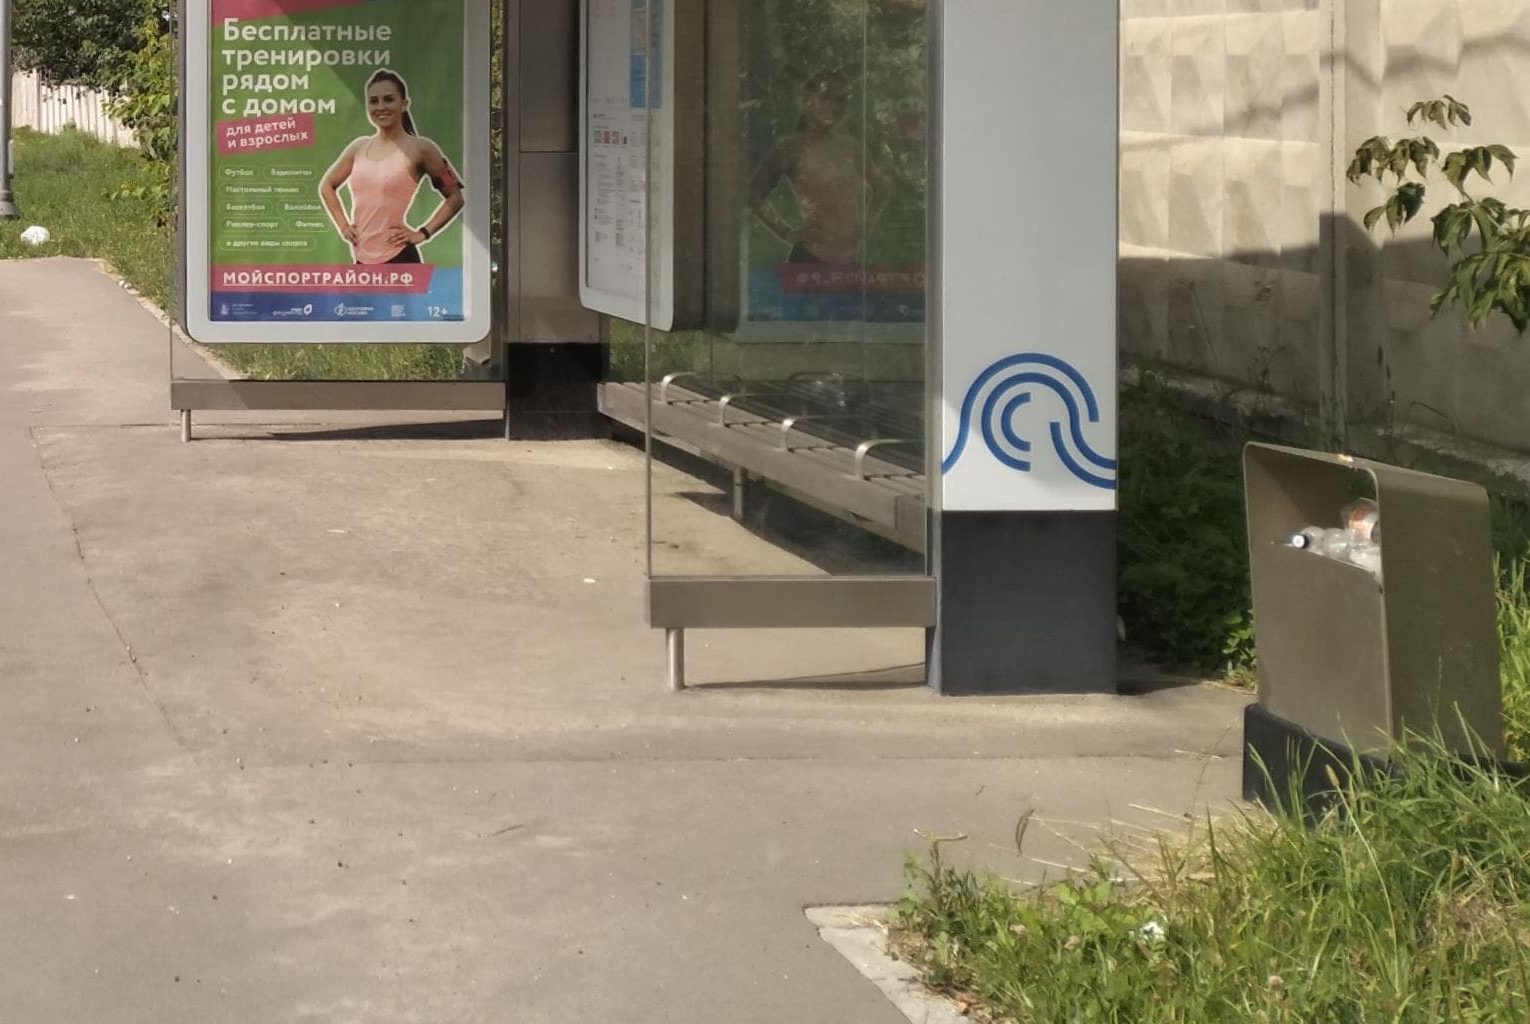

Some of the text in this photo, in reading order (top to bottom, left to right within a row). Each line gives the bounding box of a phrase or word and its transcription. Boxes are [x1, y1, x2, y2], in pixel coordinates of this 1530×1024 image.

[223, 17, 392, 41] Бесплатные
[222, 49, 390, 71] тренировки
[222, 74, 309, 95] рядом
[221, 98, 336, 117] с домом
[226, 117, 296, 137] для детей
[227, 131, 309, 149] и взрослых
[223, 269, 414, 285] МОЙСПОРТРАЙОН.РФ
[428, 306, 449, 317] 12+
